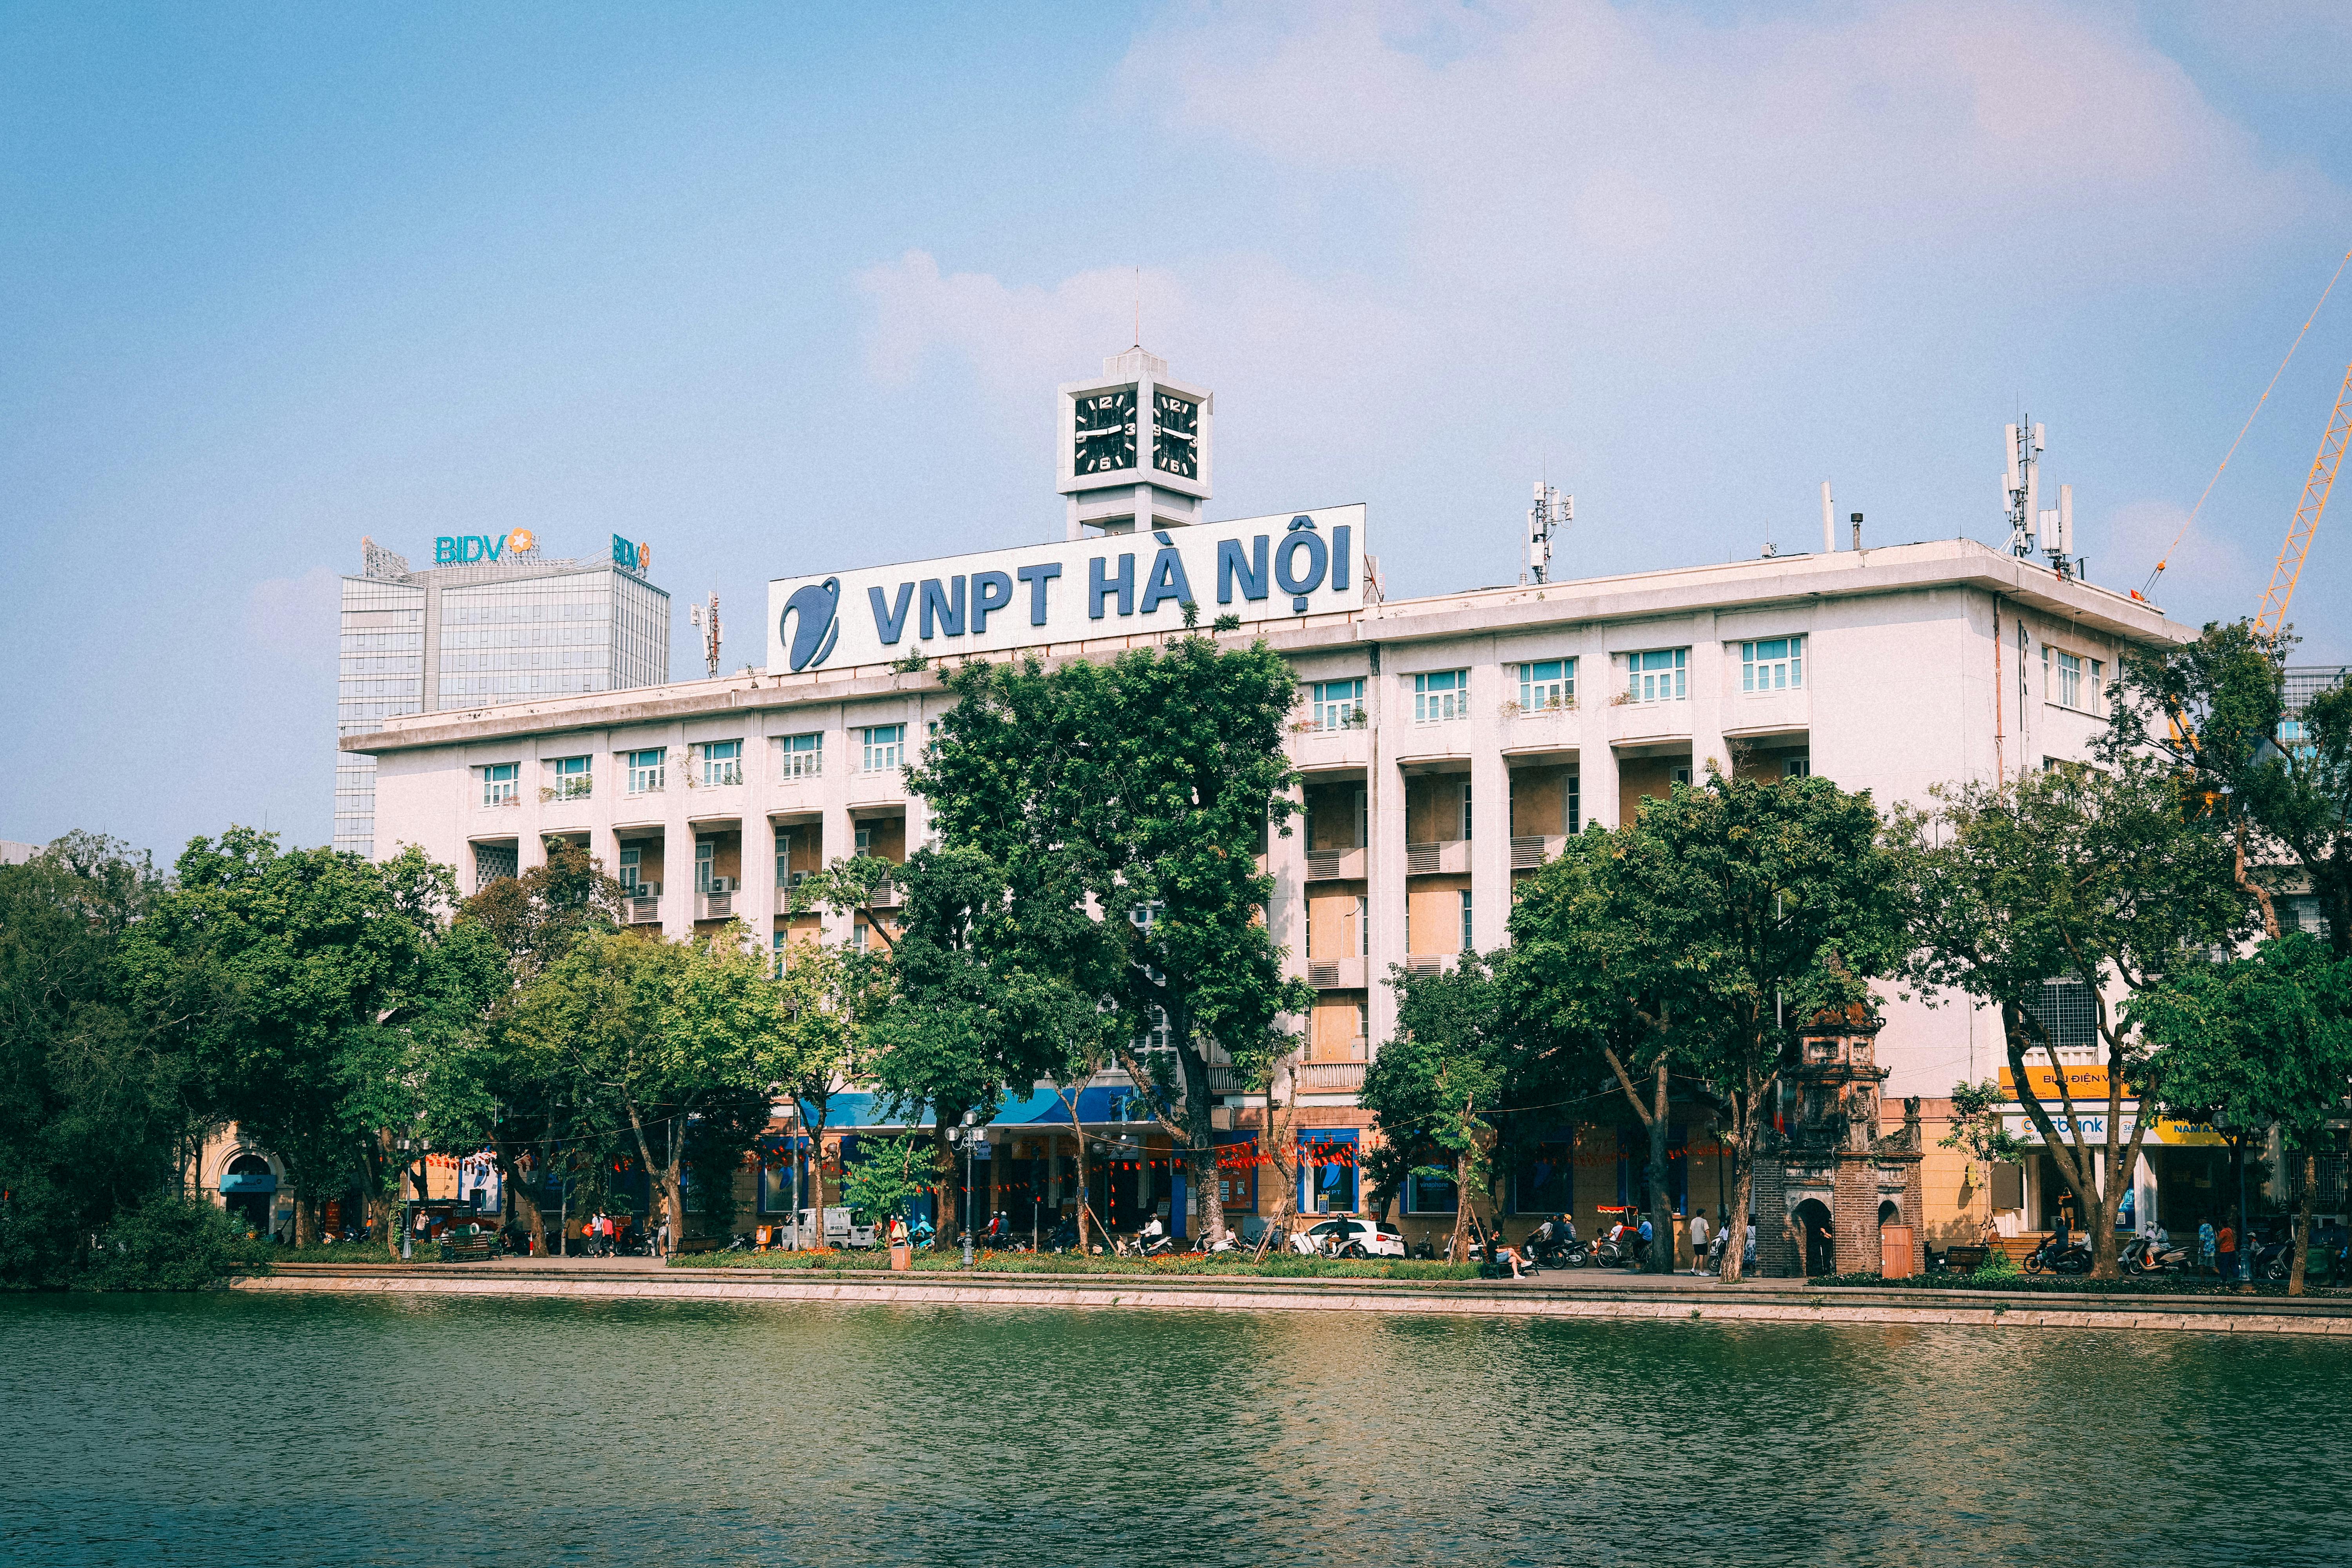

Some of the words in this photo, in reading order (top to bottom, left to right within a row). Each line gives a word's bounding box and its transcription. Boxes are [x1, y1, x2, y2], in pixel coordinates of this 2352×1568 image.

[1100, 396, 1112, 409] 12
[1170, 399, 1180, 412] 12
[1125, 423, 1136, 436] 3
[1153, 424, 1161, 437] 9
[1189, 435, 1197, 448] 3
[1100, 457, 1111, 470] 6
[1171, 460, 1179, 473] 6
[436, 535, 508, 563] BIDV
[612, 534, 640, 571] BIDV
[868, 563, 1062, 644] VNPT
[1089, 532, 1194, 619] HÀ
[1217, 516, 1351, 612] NỘI
[2071, 1073, 2100, 1085] ĐIỆN
